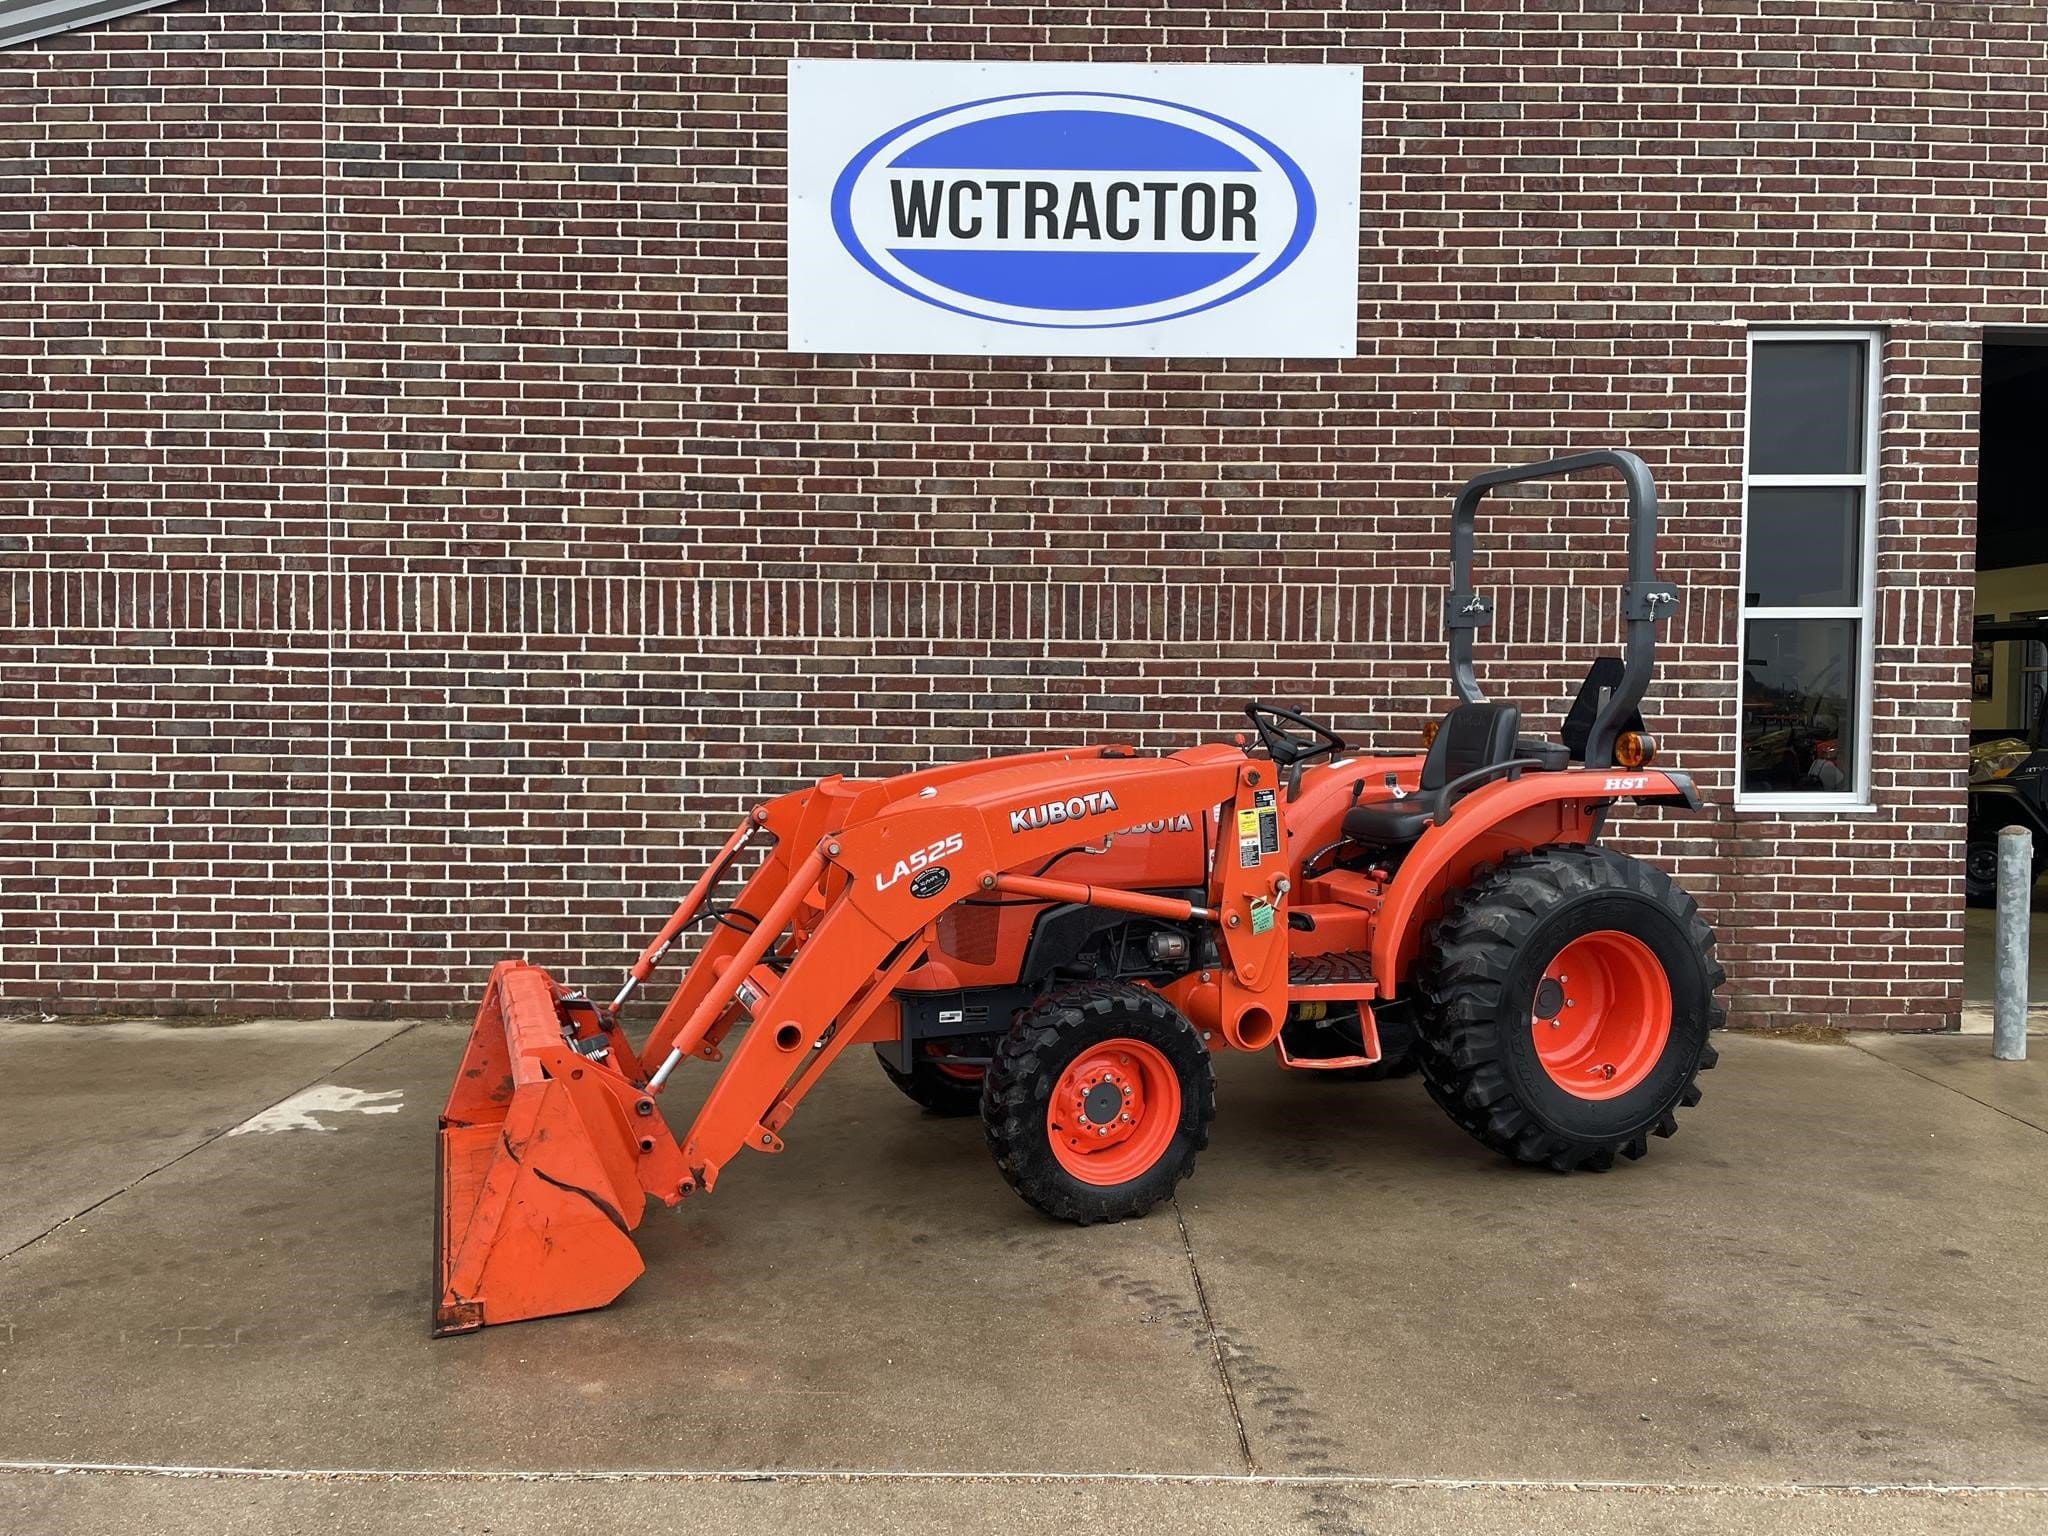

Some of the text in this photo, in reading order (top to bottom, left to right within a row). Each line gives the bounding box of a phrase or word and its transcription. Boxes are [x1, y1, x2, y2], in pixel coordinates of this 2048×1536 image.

[890, 179, 1257, 242] WCTRACTOR
[1604, 777, 1648, 791] HST
[1009, 790, 1119, 834] KUBOTA
[875, 832, 964, 892] LA525
